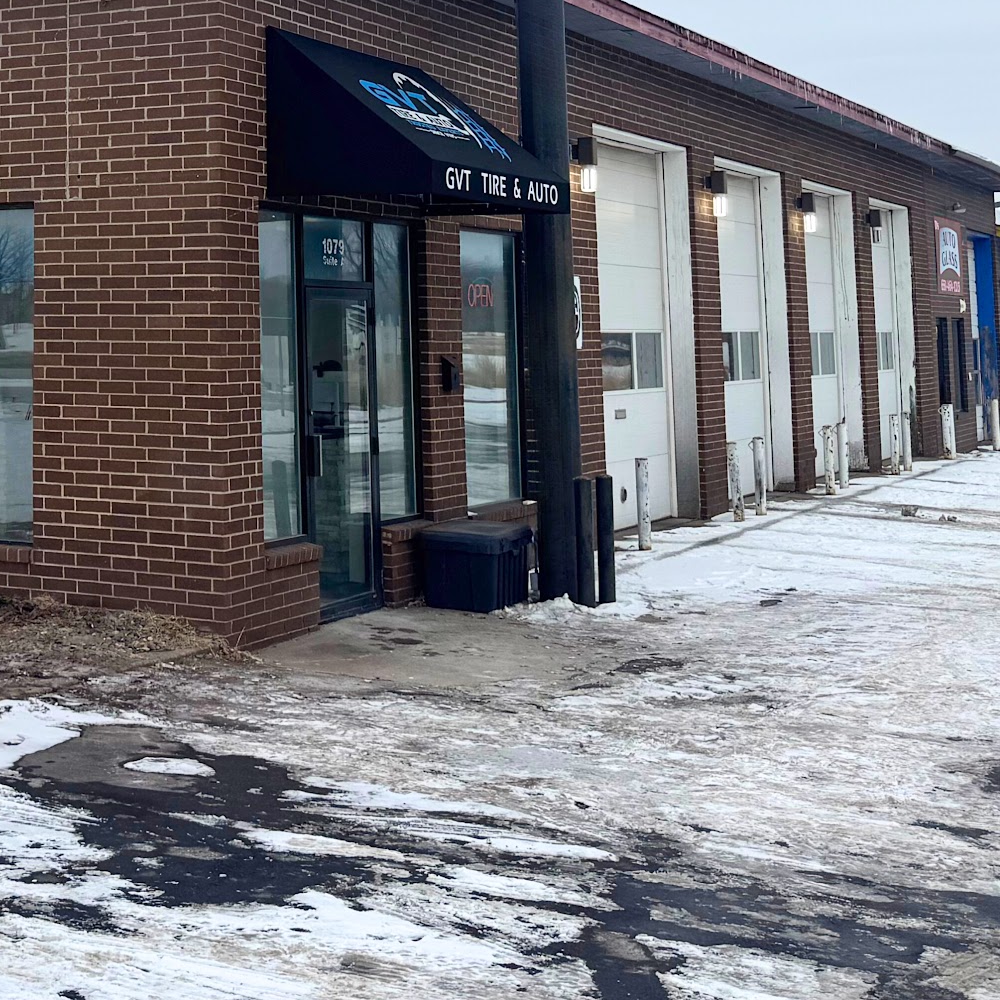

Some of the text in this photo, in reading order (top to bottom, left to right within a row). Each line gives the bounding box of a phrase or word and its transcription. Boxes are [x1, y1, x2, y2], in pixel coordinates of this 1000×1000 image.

[359, 79, 438, 115] GVT
[446, 167, 559, 204] GVT TIRE & AUTO
[322, 238, 345, 255] 1079
[942, 231, 956, 249] AUTO
[941, 250, 958, 269] GLASS
[467, 284, 493, 307] OPEN
